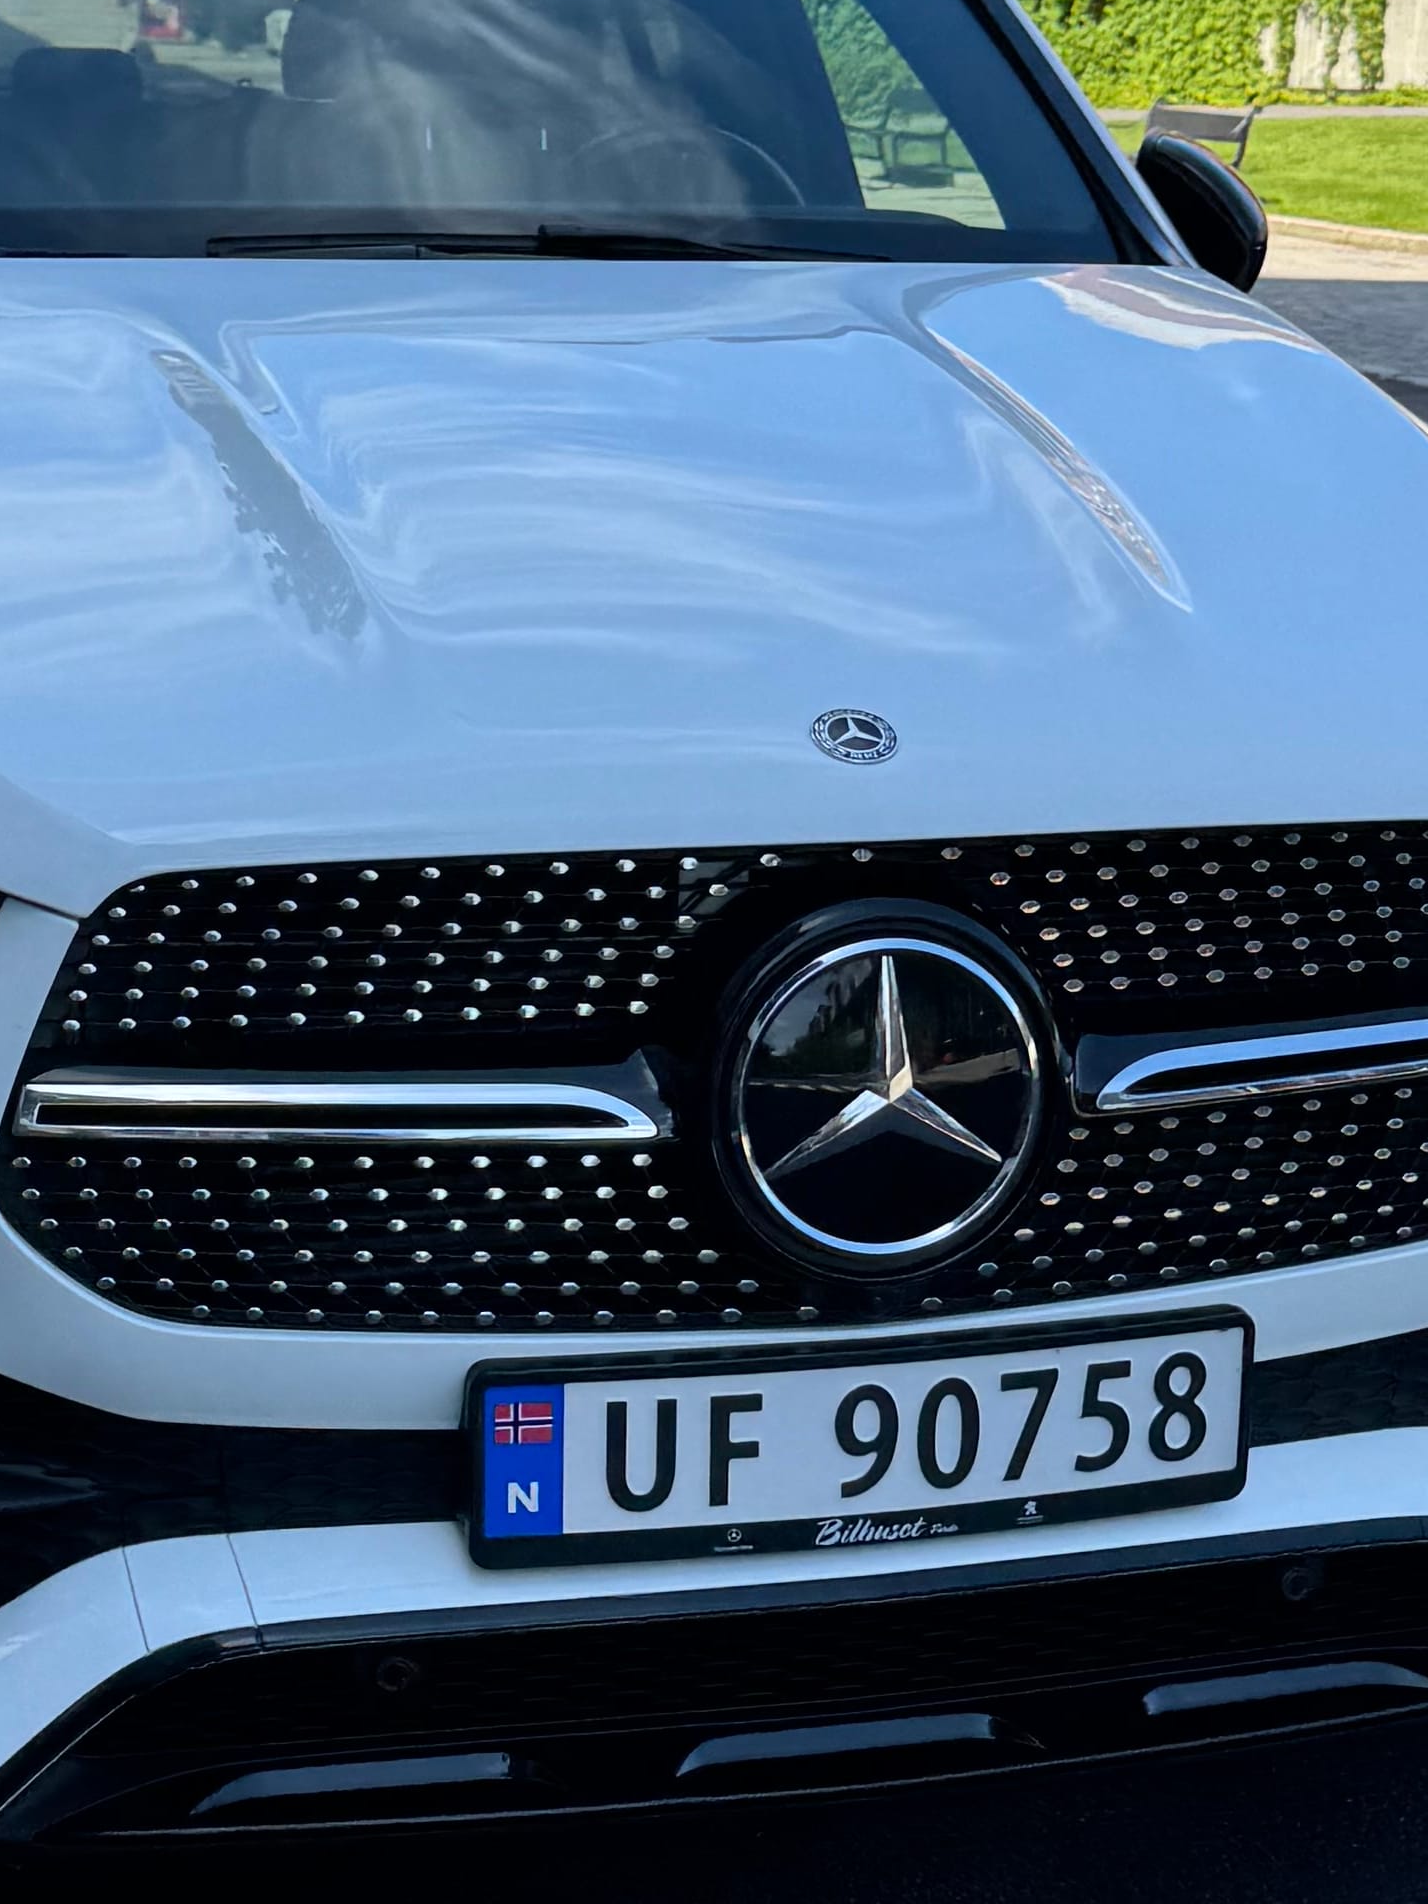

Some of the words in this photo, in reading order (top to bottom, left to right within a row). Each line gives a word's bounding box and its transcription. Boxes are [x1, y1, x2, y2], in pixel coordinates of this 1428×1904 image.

[604, 1393, 764, 1514] UF
[834, 1351, 1208, 1500] 90758
[507, 1481, 541, 1514] N
